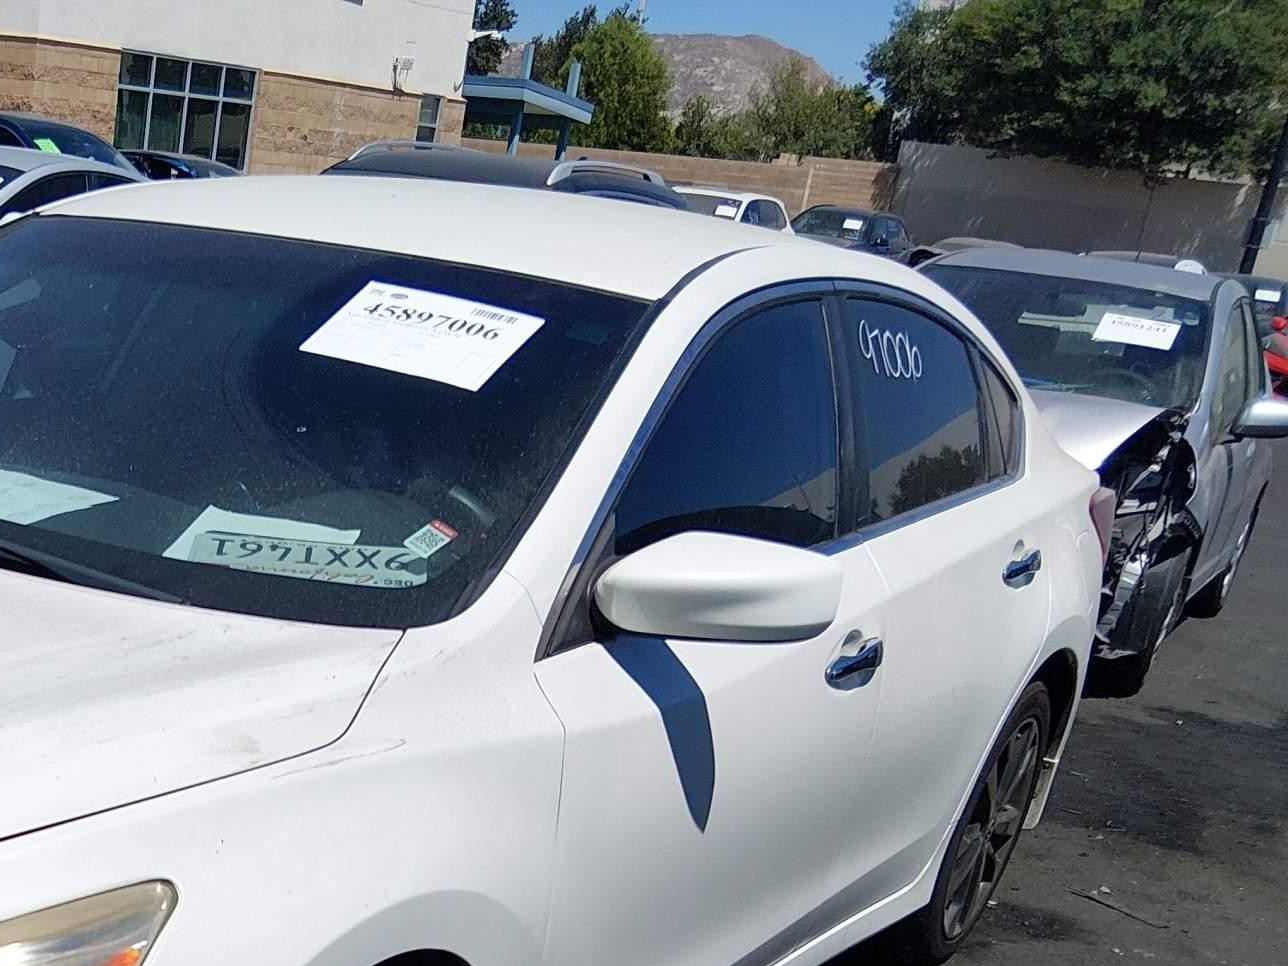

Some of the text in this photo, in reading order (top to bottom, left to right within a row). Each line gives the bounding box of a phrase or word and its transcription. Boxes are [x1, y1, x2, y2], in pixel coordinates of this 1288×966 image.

[363, 302, 504, 341] 45897006
[859, 319, 922, 382] 97006
[211, 538, 412, 571] 9XXT461
